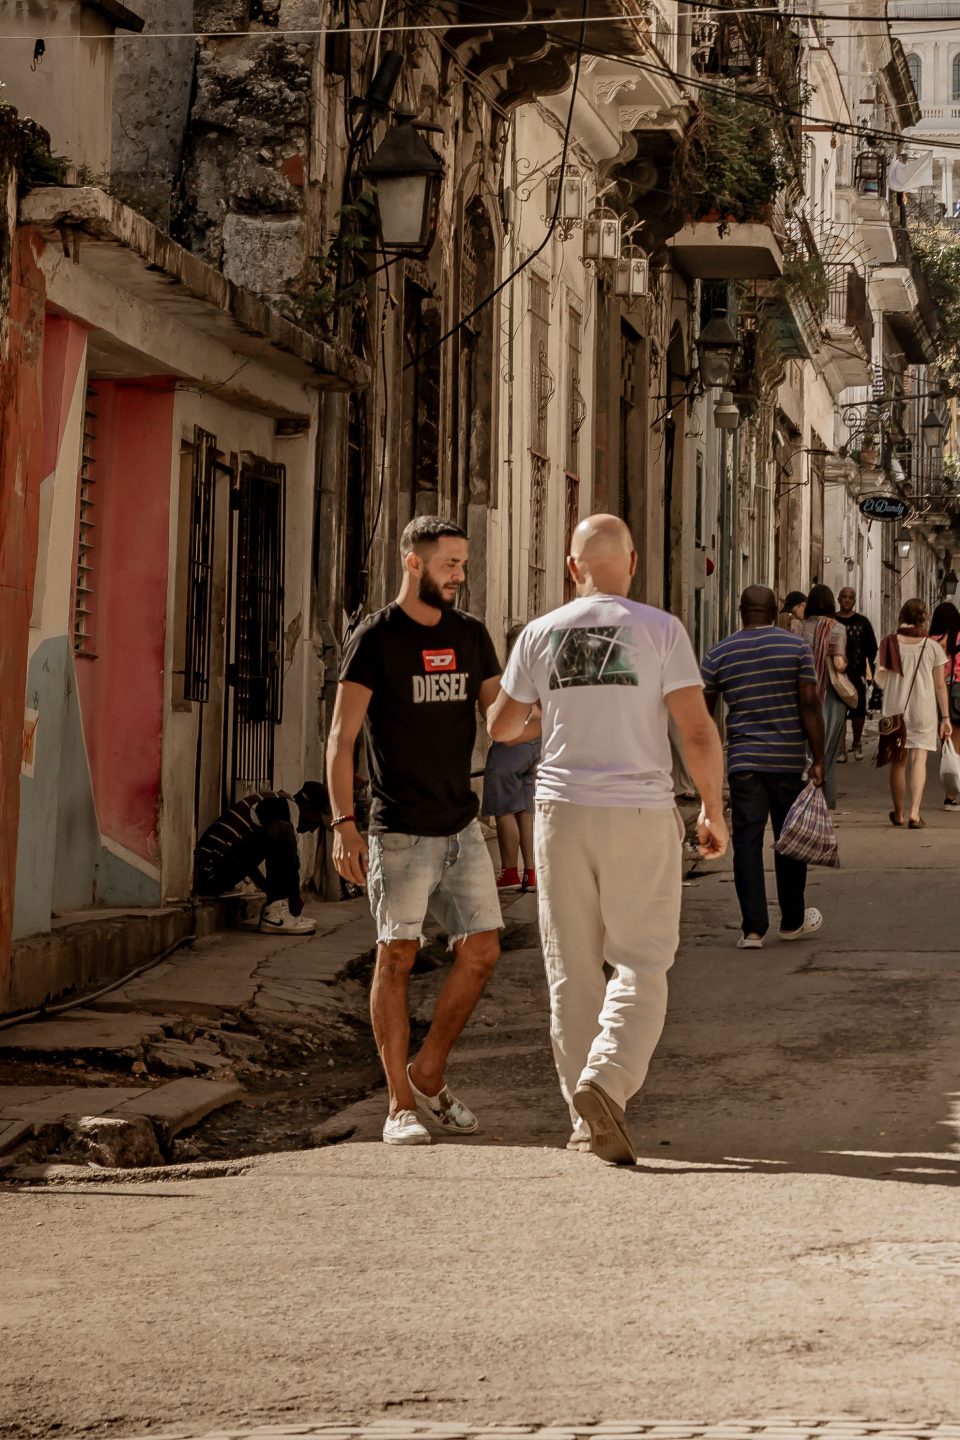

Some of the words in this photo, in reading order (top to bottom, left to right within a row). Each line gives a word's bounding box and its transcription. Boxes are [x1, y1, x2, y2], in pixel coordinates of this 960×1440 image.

[863, 499, 874, 511] El
[875, 499, 904, 516] Dandy
[412, 673, 468, 703] DIESEL
